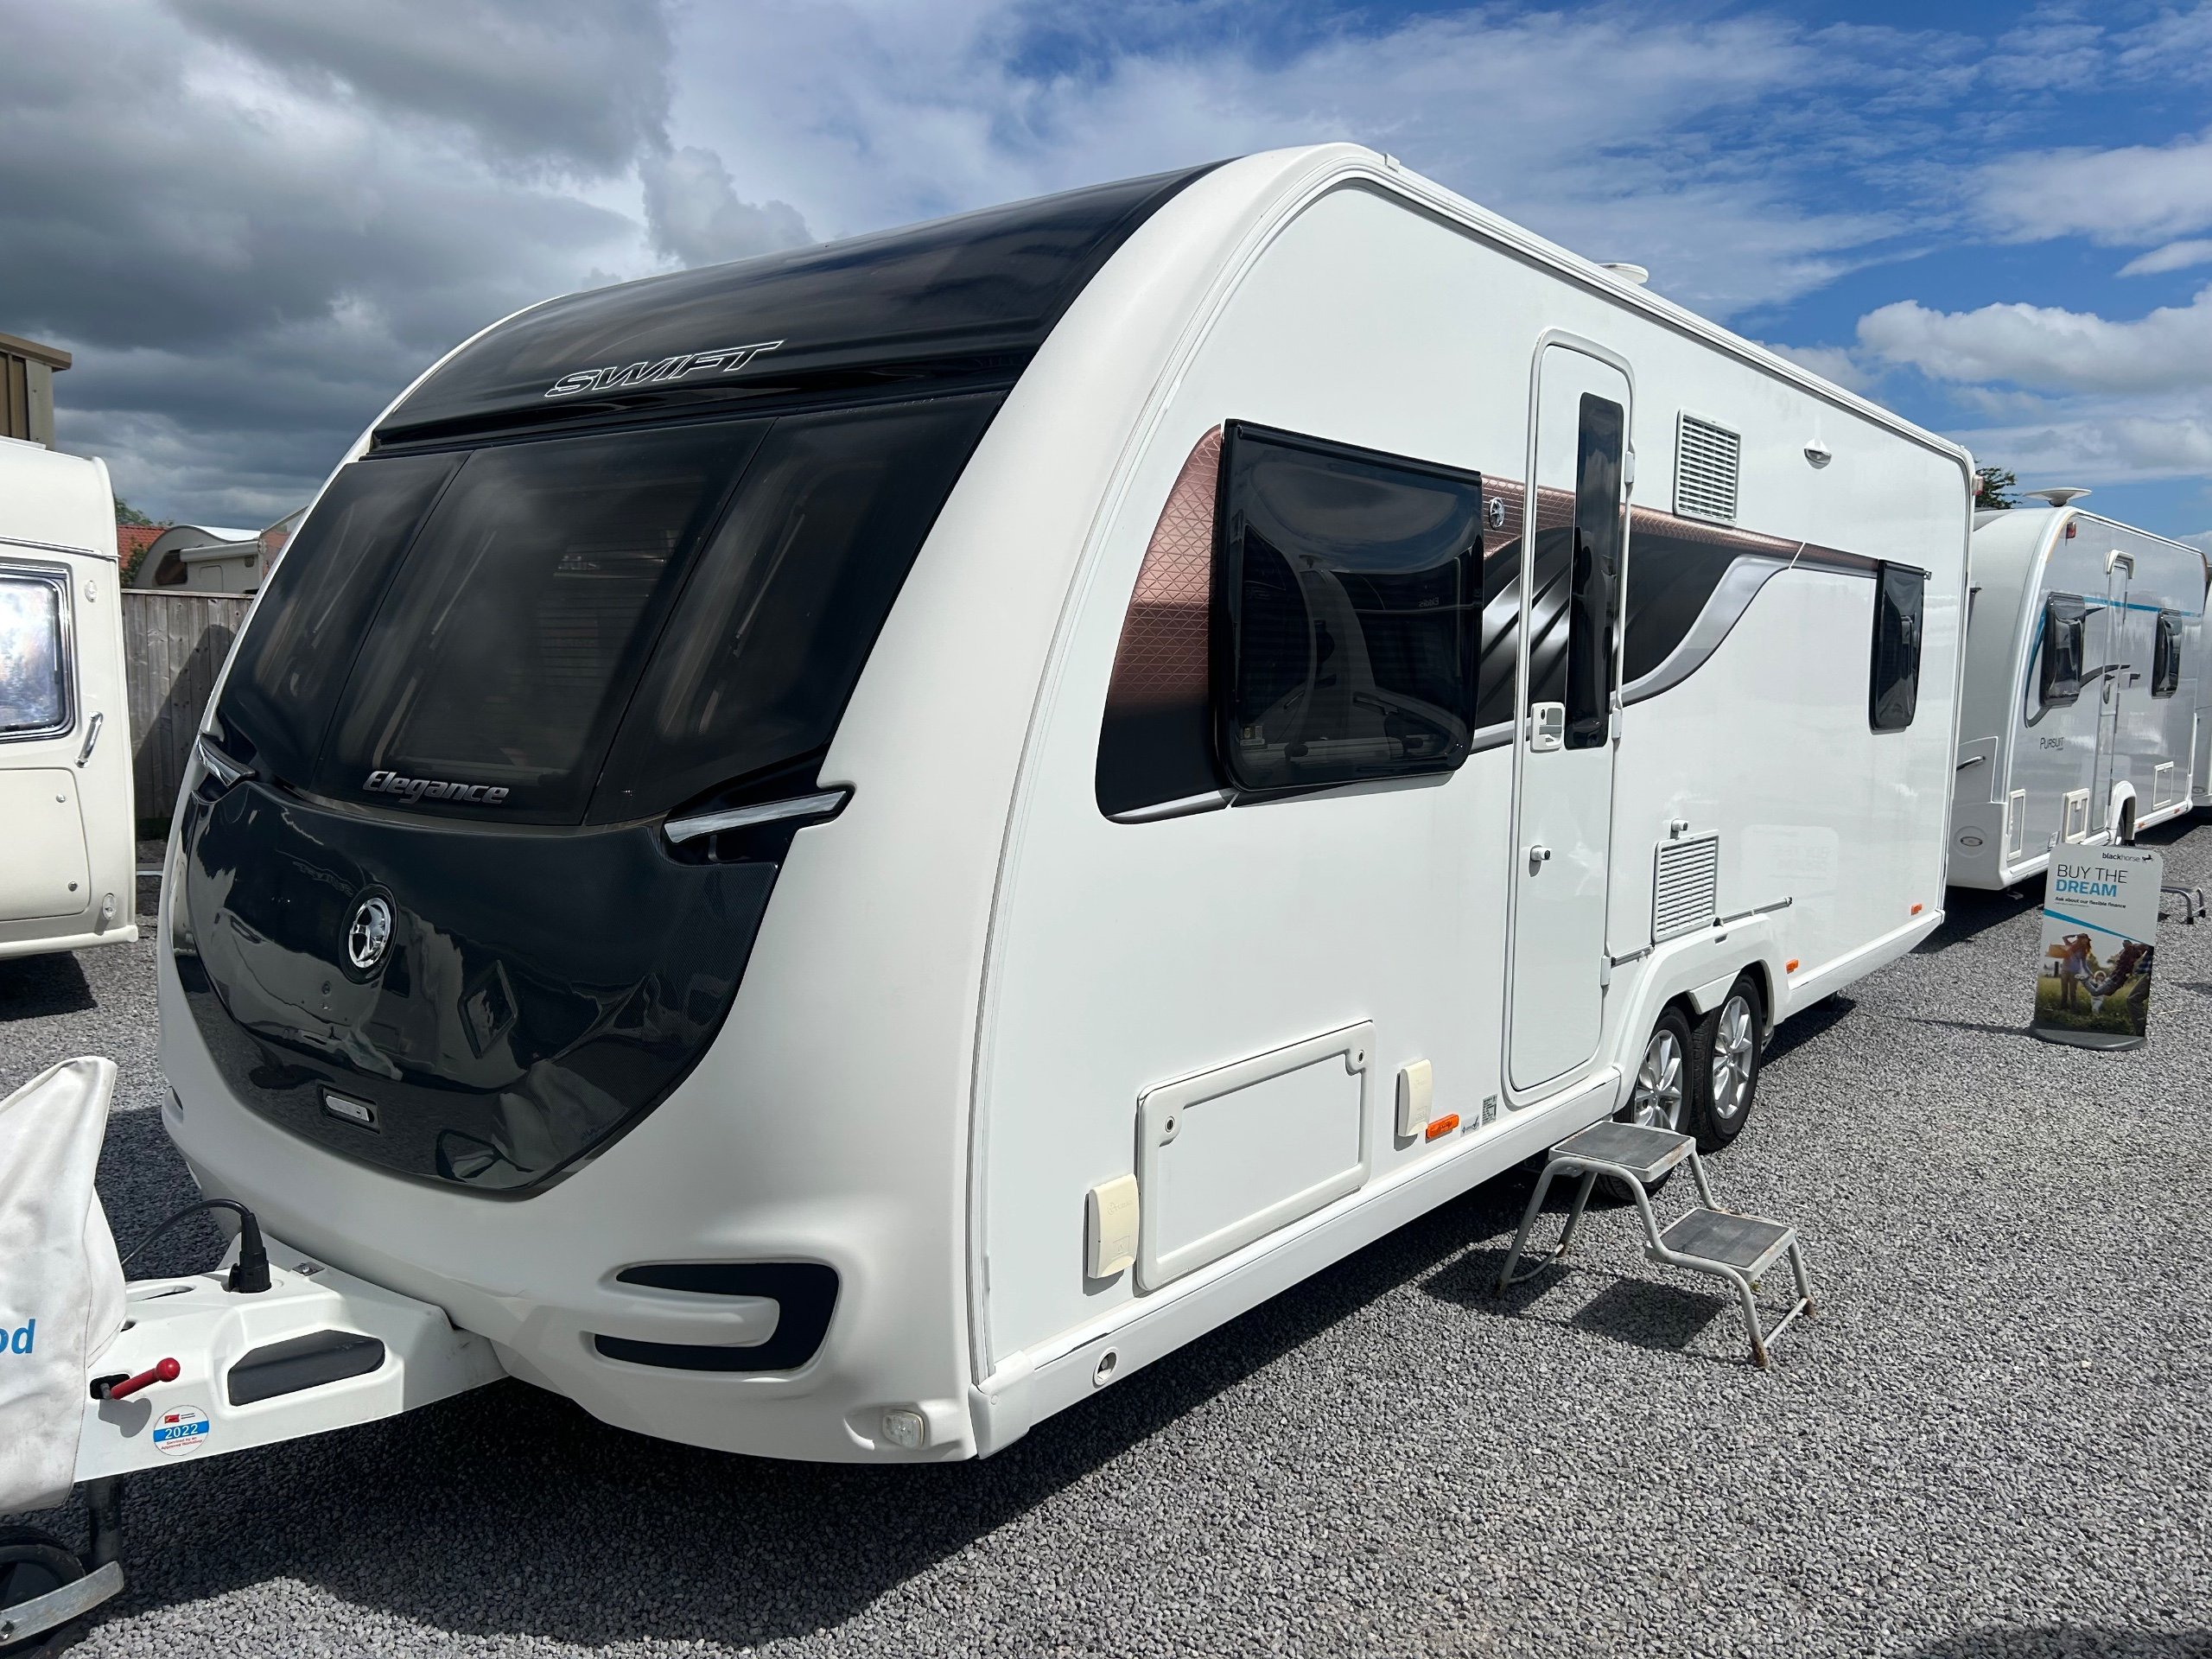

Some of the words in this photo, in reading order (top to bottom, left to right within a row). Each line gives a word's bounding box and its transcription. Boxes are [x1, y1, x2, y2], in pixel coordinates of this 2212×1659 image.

[544, 340, 785, 397] SWIFT
[362, 770, 510, 804] Elegance
[2101, 852, 2141, 861] blackhorse
[2056, 864, 2091, 879] BUY
[2095, 868, 2128, 883] THE
[2056, 879, 2117, 897] DREAM
[164, 1423, 198, 1439] 2022
